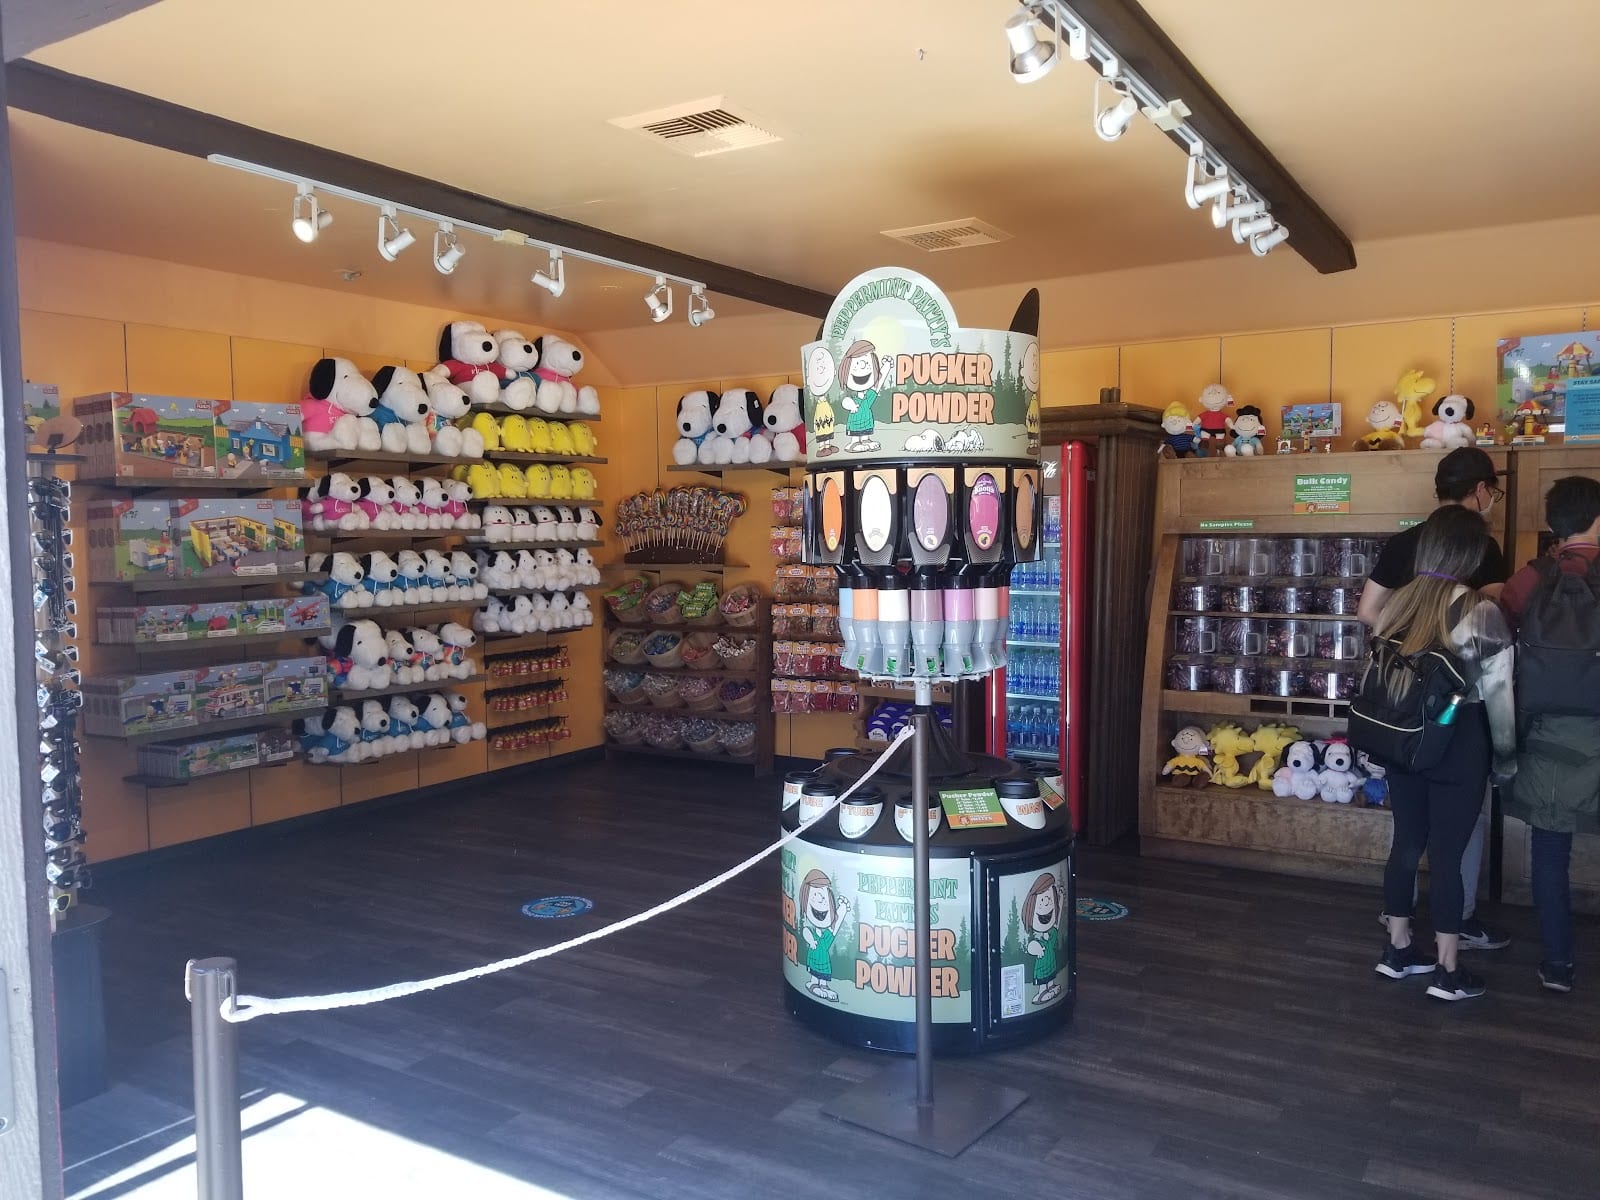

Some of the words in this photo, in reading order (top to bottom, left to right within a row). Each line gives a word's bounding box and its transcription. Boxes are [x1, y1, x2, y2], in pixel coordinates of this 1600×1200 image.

[831, 277, 912, 340] PEPPERMINT
[907, 285, 951, 348] PATTY'S
[895, 352, 993, 387] PUCKER
[892, 390, 995, 425] POWDER
[1319, 477, 1348, 485] Candy
[848, 806, 875, 817] TUBE
[857, 872, 958, 900] PEPPERINT
[874, 900, 940, 925] PATTS
